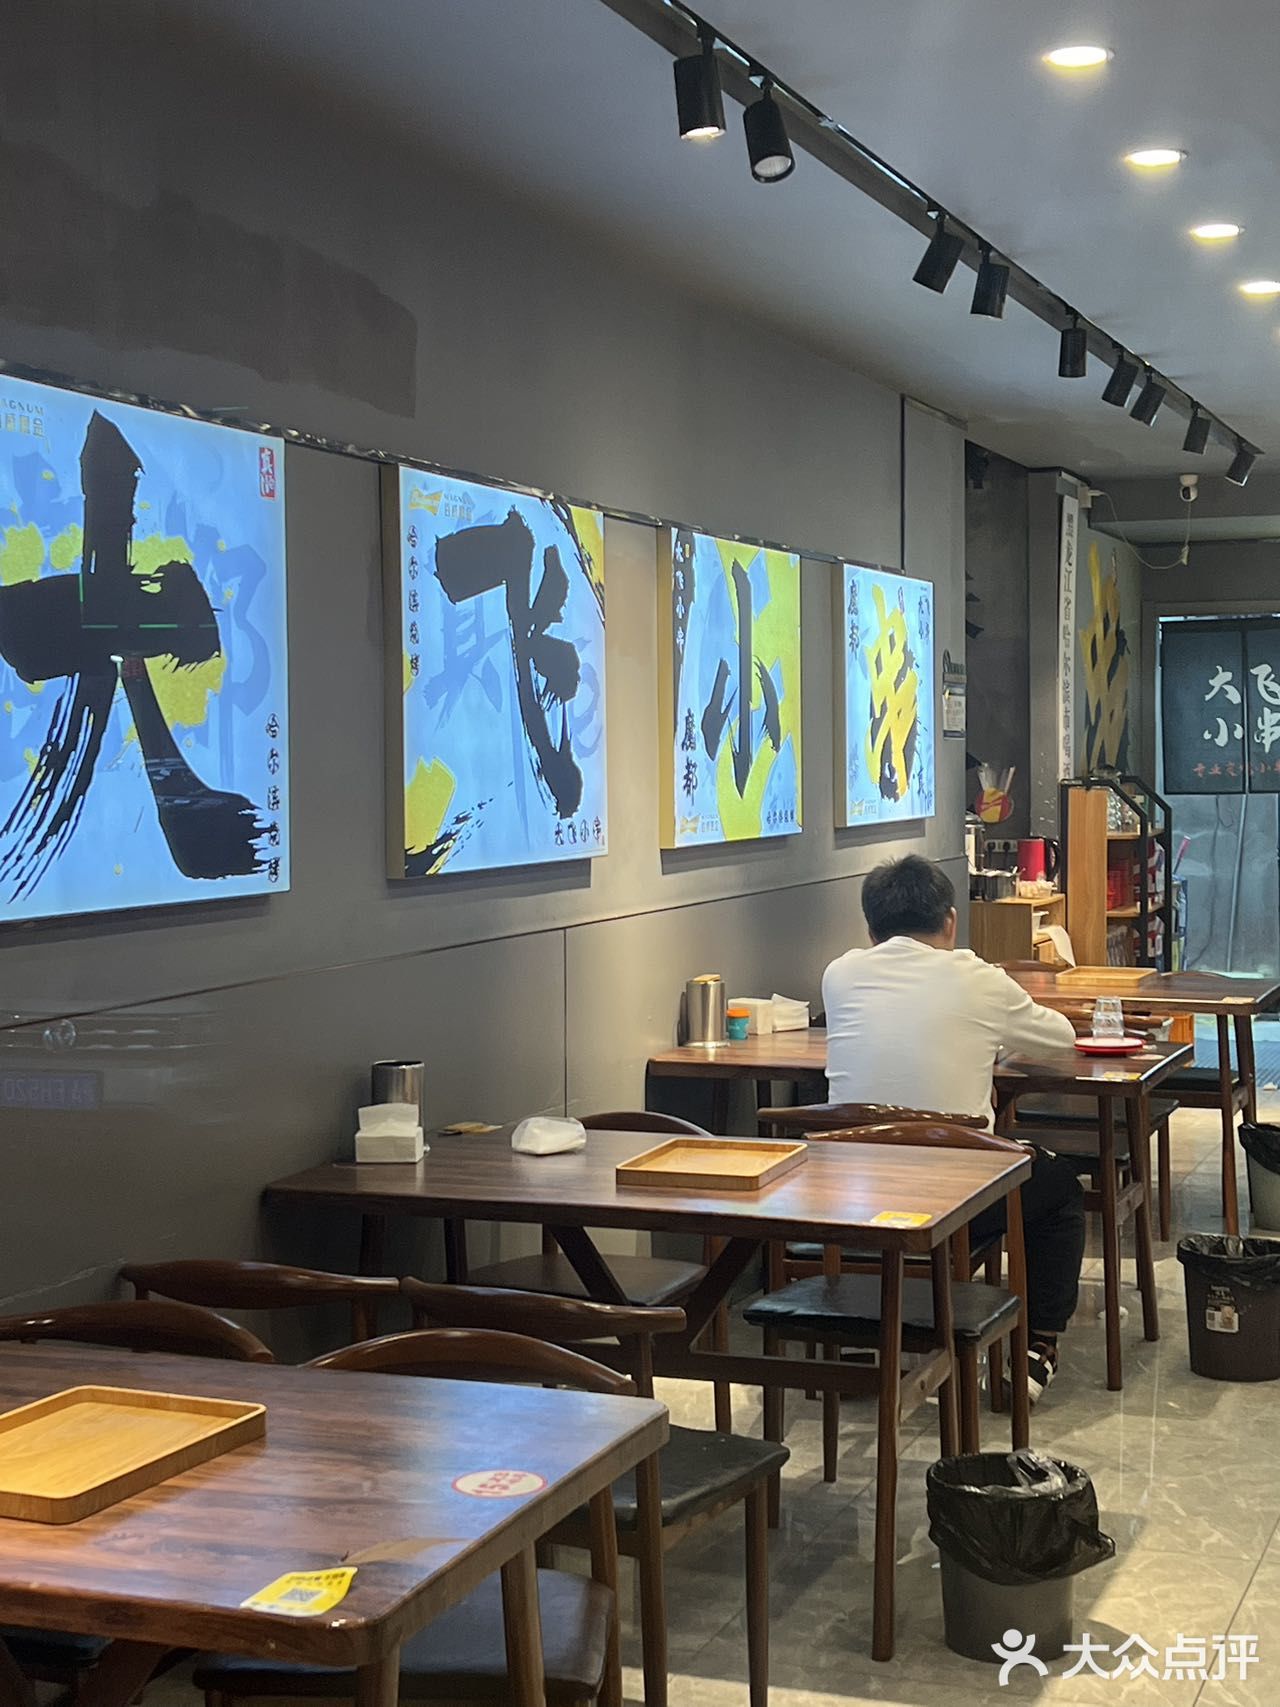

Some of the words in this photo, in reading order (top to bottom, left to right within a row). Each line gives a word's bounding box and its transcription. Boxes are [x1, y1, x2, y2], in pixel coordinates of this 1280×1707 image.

[701, 557, 781, 800] 小
[1204, 663, 1280, 706] 大飞
[1203, 706, 1280, 754] 小串
